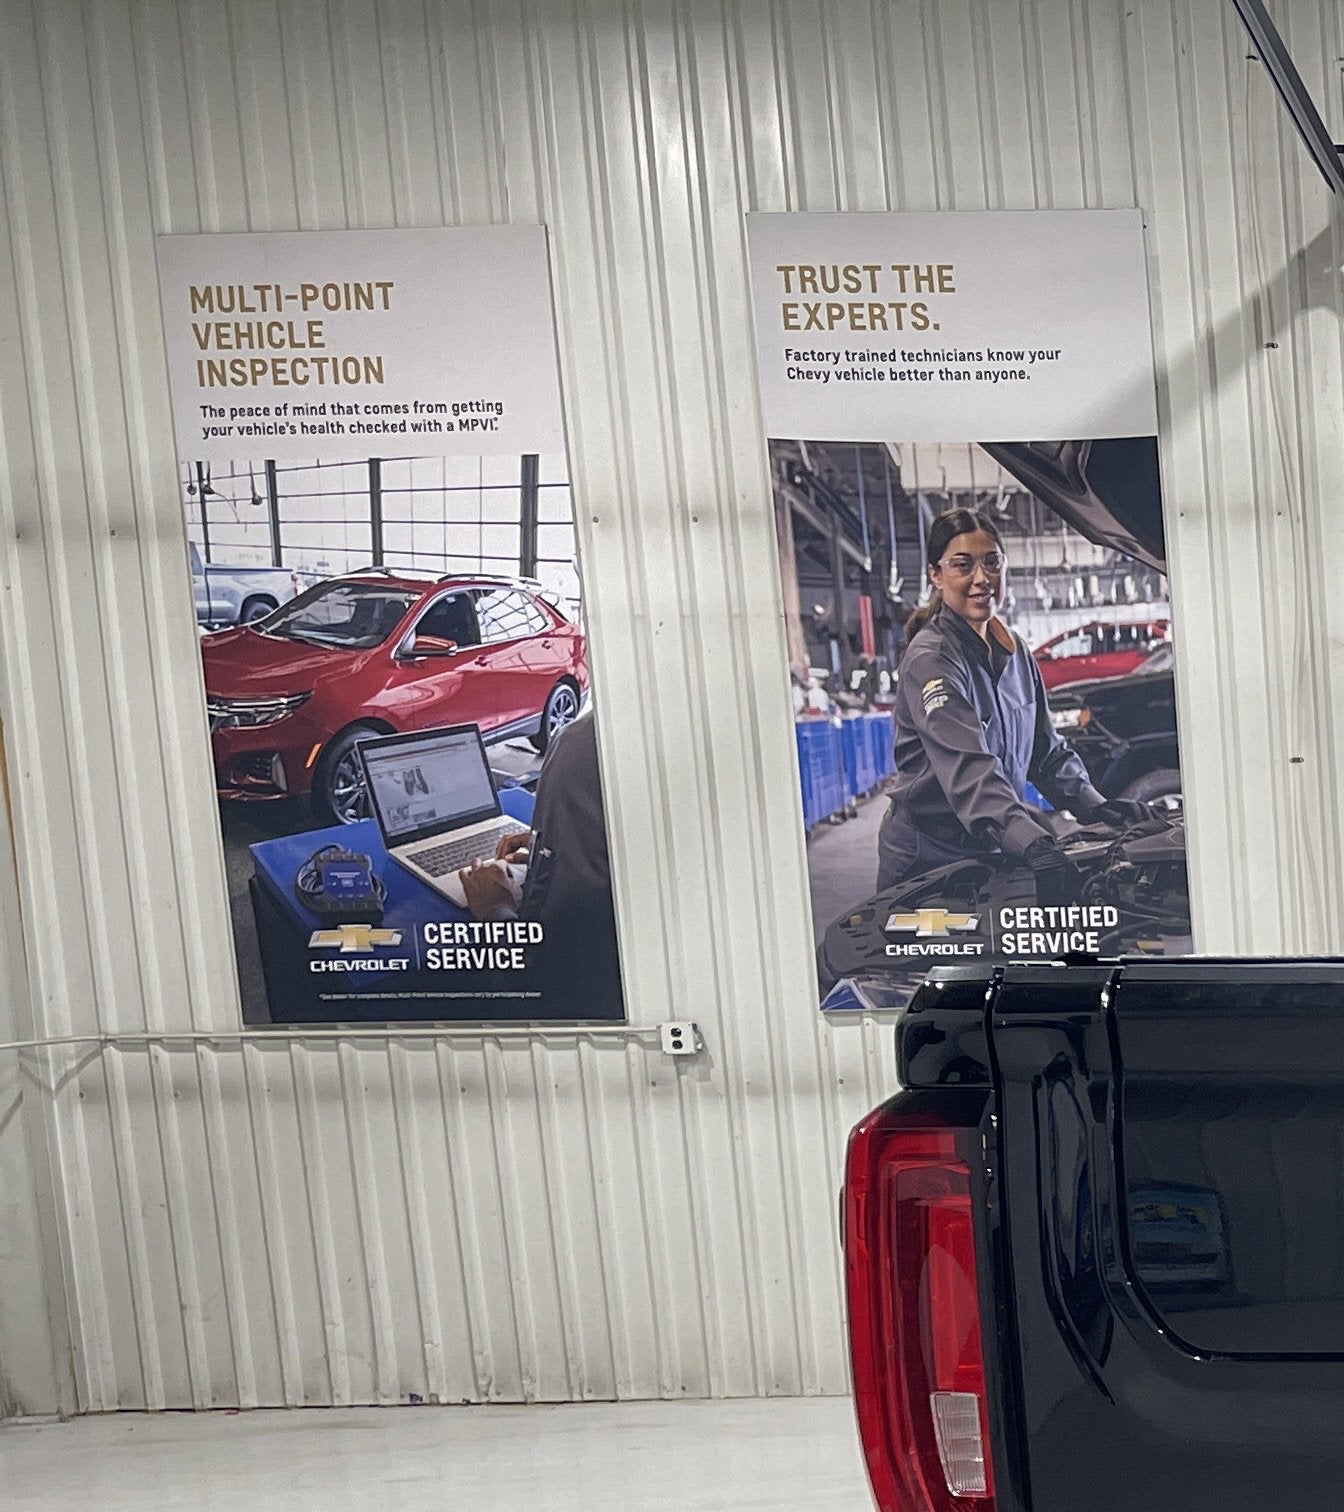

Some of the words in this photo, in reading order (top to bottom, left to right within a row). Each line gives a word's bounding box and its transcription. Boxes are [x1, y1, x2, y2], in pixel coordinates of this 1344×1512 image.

[776, 264, 882, 294] TRUST
[891, 264, 956, 293] THE
[189, 281, 394, 314] MULTI-POINT
[782, 302, 940, 331] EXPERTS.
[191, 320, 326, 351] VEHICLE
[785, 348, 840, 365] Factory
[845, 348, 896, 362] trained
[901, 348, 983, 362] technicians
[987, 347, 1025, 362] know
[1028, 350, 1061, 364] your
[197, 356, 384, 388] INSPECTION
[787, 367, 831, 384] Chevy
[835, 367, 885, 381] vehicle
[889, 367, 934, 381] better
[939, 367, 971, 381] than
[975, 369, 1031, 384] anyone.
[200, 404, 226, 419] The
[230, 405, 270, 421] peace
[274, 403, 288, 417] of
[292, 402, 327, 416] mind
[330, 401, 360, 416] that
[364, 403, 409, 415] comes
[413, 401, 448, 414] from
[451, 399, 503, 416] getting
[202, 424, 233, 440] your
[237, 421, 297, 436] vehicle's
[300, 420, 345, 435] health
[349, 419, 407, 434] checked
[410, 418, 442, 433] with
[446, 420, 455, 432] a
[1000, 905, 1119, 929] CERTIFIED
[424, 922, 544, 944] CERTIFIED
[1001, 931, 1100, 955] SERVICE
[426, 947, 526, 970] SERVICE
[885, 943, 985, 956] CHEVROLET
[309, 958, 410, 973] CHEVROLET
